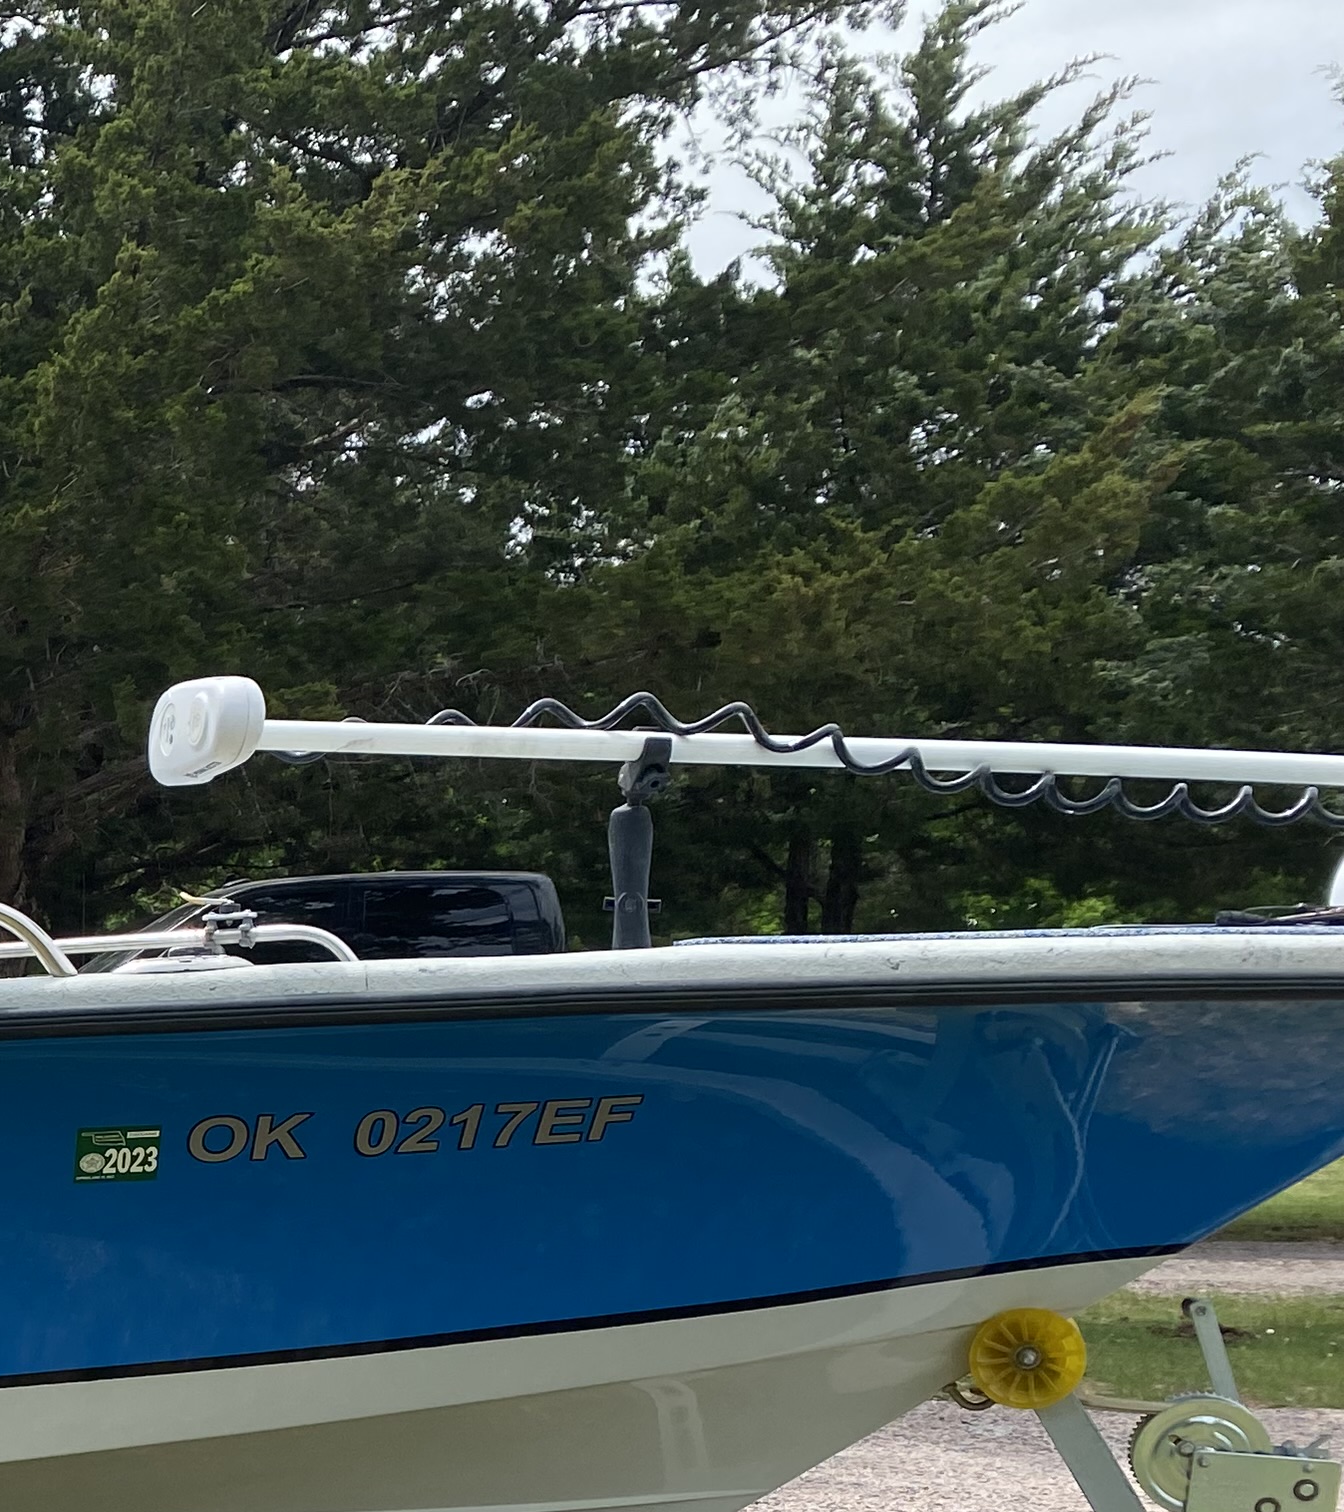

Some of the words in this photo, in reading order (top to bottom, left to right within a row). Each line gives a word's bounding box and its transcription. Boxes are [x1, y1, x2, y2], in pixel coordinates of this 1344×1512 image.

[186, 1112, 315, 1164] OK
[353, 1094, 645, 1158] 0217EF
[102, 1146, 159, 1174] 2023
